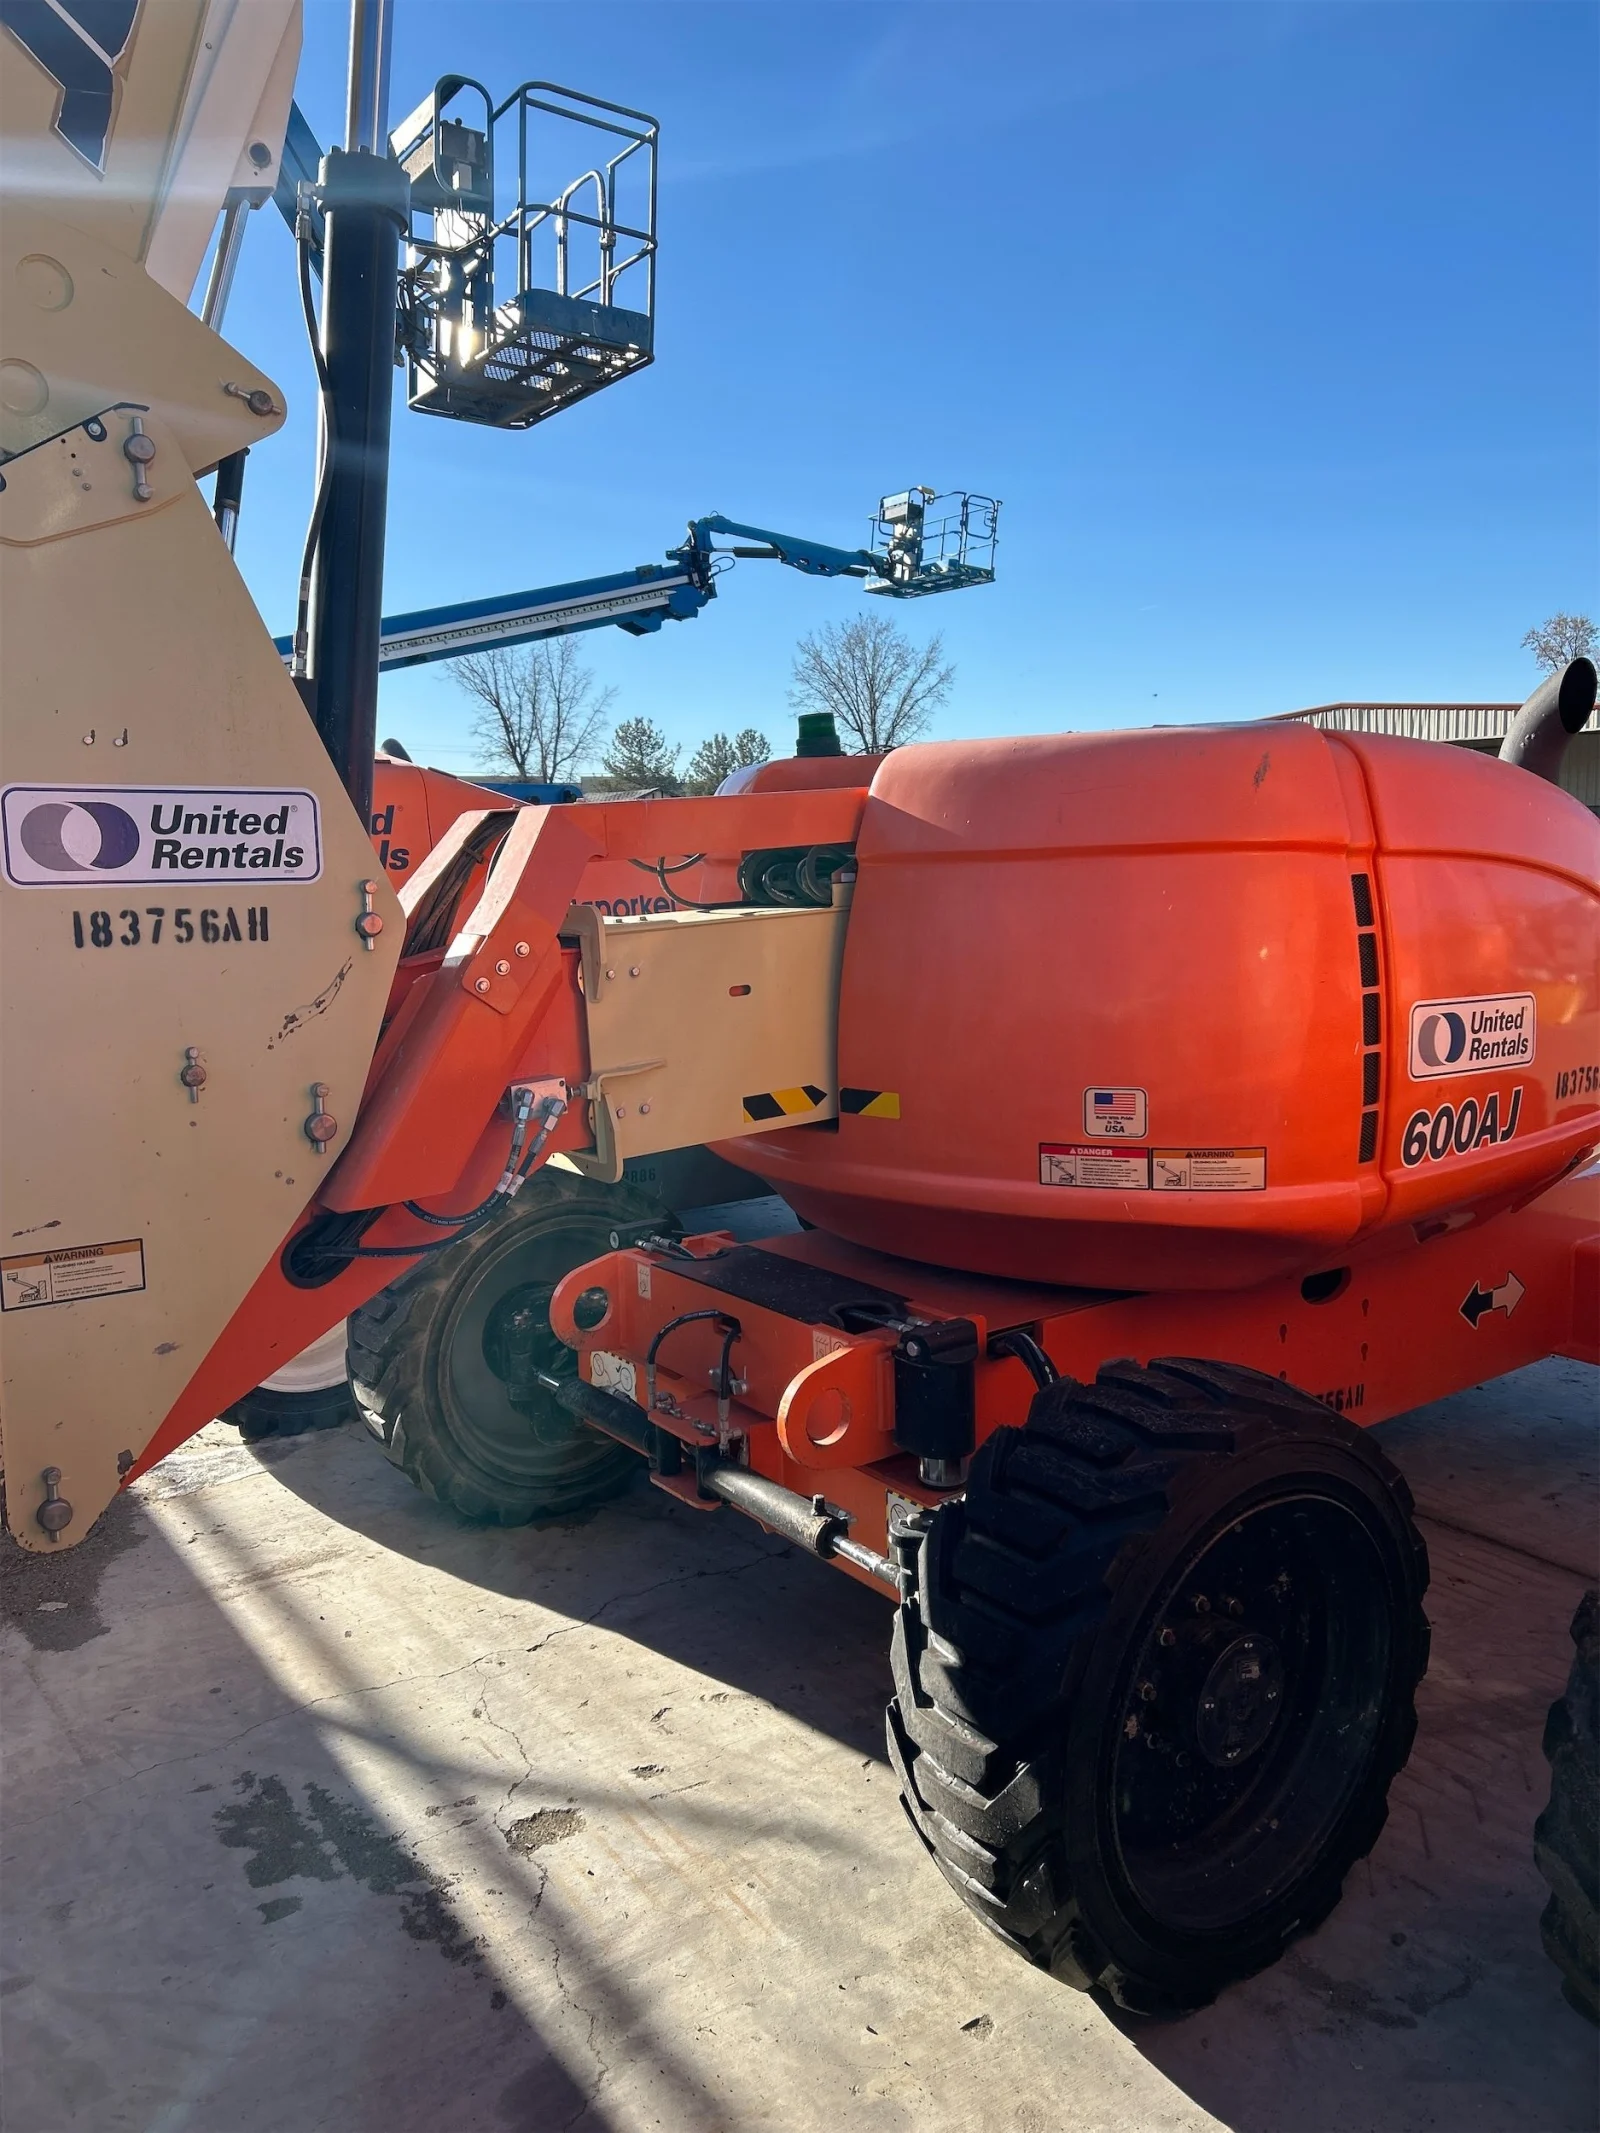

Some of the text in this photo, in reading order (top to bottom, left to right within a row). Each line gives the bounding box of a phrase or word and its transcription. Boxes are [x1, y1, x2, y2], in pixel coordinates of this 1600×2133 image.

[151, 838, 304, 869] Rentals
[1469, 1033, 1529, 1061] Rentals
[1555, 1066, 1600, 1100] 183756
[1105, 1125, 1125, 1133] USA
[1402, 1087, 1523, 1167] 600AJ
[1077, 1147, 1113, 1156] DANGER
[1193, 1150, 1235, 1158] WARNING
[53, 1247, 104, 1262] WARNING
